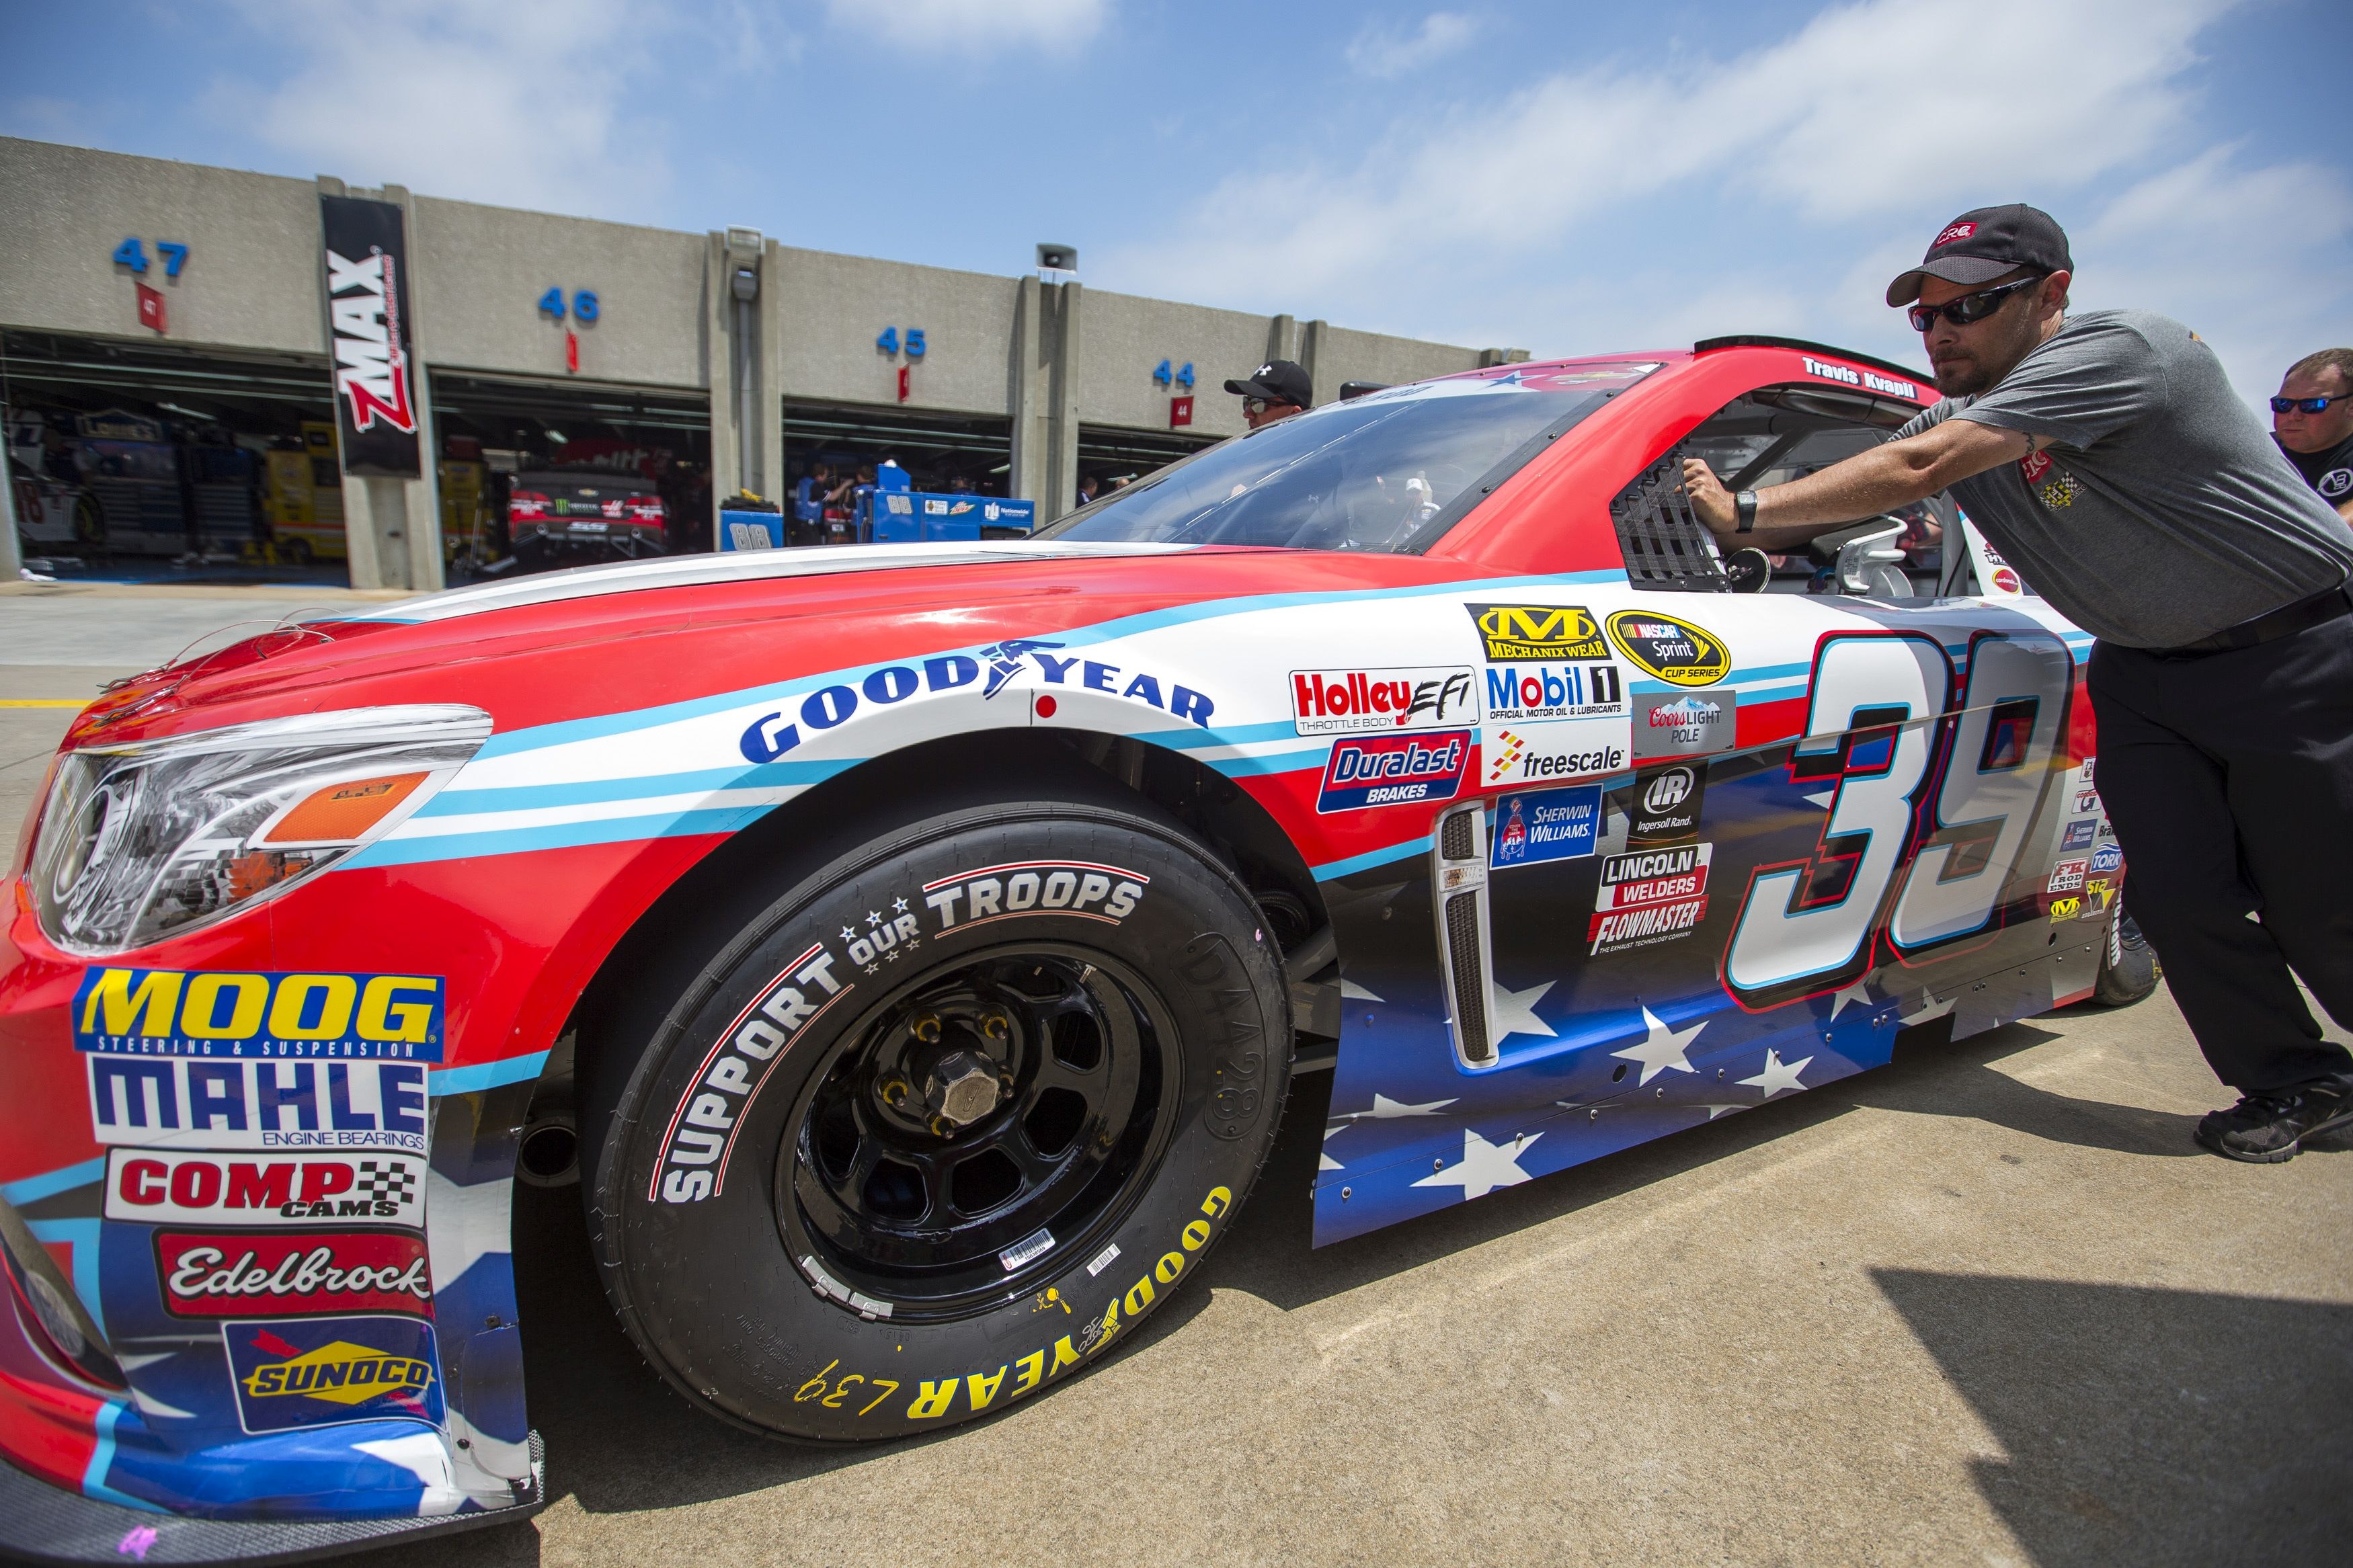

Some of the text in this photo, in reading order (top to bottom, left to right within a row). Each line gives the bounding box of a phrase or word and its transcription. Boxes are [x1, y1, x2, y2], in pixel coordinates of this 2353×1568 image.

[1937, 226, 1972, 245] CRC
[113, 237, 188, 276] 47
[539, 286, 600, 321] 46
[877, 325, 926, 356] 45
[1153, 358, 1195, 386] 44
[1801, 356, 1916, 399] Travis Kvapil
[1177, 405, 1187, 416] 44
[887, 495, 912, 514] 88
[729, 524, 772, 550] 88
[1639, 624, 1681, 638] NASCAR
[1487, 639, 1607, 659] MECHANIX WEAR
[1652, 641, 1694, 661] Sprint
[1665, 668, 1720, 677] CUP SERIES
[1293, 673, 1473, 726] Holley EFI
[1486, 667, 1611, 709] Mobil 1
[1300, 716, 1394, 731] THROTTLE BODY
[1490, 704, 1622, 720] OFFICIAL MOTOR OIL & LUBRICANTS
[1671, 728, 1700, 744] POLE
[1332, 739, 1460, 784] Duralast
[1523, 745, 1622, 778] freescale
[1365, 784, 1428, 803] BRAKES
[1651, 774, 1687, 807] IR
[1533, 804, 1592, 825] SHERWIN
[1637, 815, 1691, 833] Ingersoll Rand
[1725, 632, 2073, 998] 39
[1530, 823, 1590, 844] WILLIAMS
[1607, 850, 1693, 882] LINCOLN
[2093, 852, 2122, 869] TORK
[1623, 876, 1696, 903] WELDERS
[2049, 881, 2081, 892] ENDS
[2058, 874, 2083, 883] ROD
[926, 871, 1143, 929] TROOPS
[848, 912, 918, 966] OUR
[1590, 901, 1700, 956] FLOWMASTER
[1610, 942, 1634, 952] EXHAUST
[1634, 935, 1669, 946] TECHNOLOGY
[1668, 930, 1692, 941] COMPANY
[80, 968, 438, 1044] MOOG
[97, 1035, 414, 1058] STEERING & SUSPENSION
[662, 952, 842, 1204] SUPPORT
[92, 1057, 425, 1132] MAHLE
[263, 1131, 425, 1151] ENGINE BEARINGS
[119, 1161, 354, 1210] COMP
[280, 1200, 399, 1218] CAMS
[168, 1246, 432, 1299] Edelbrock
[255, 1359, 432, 1393] SUNOCO
